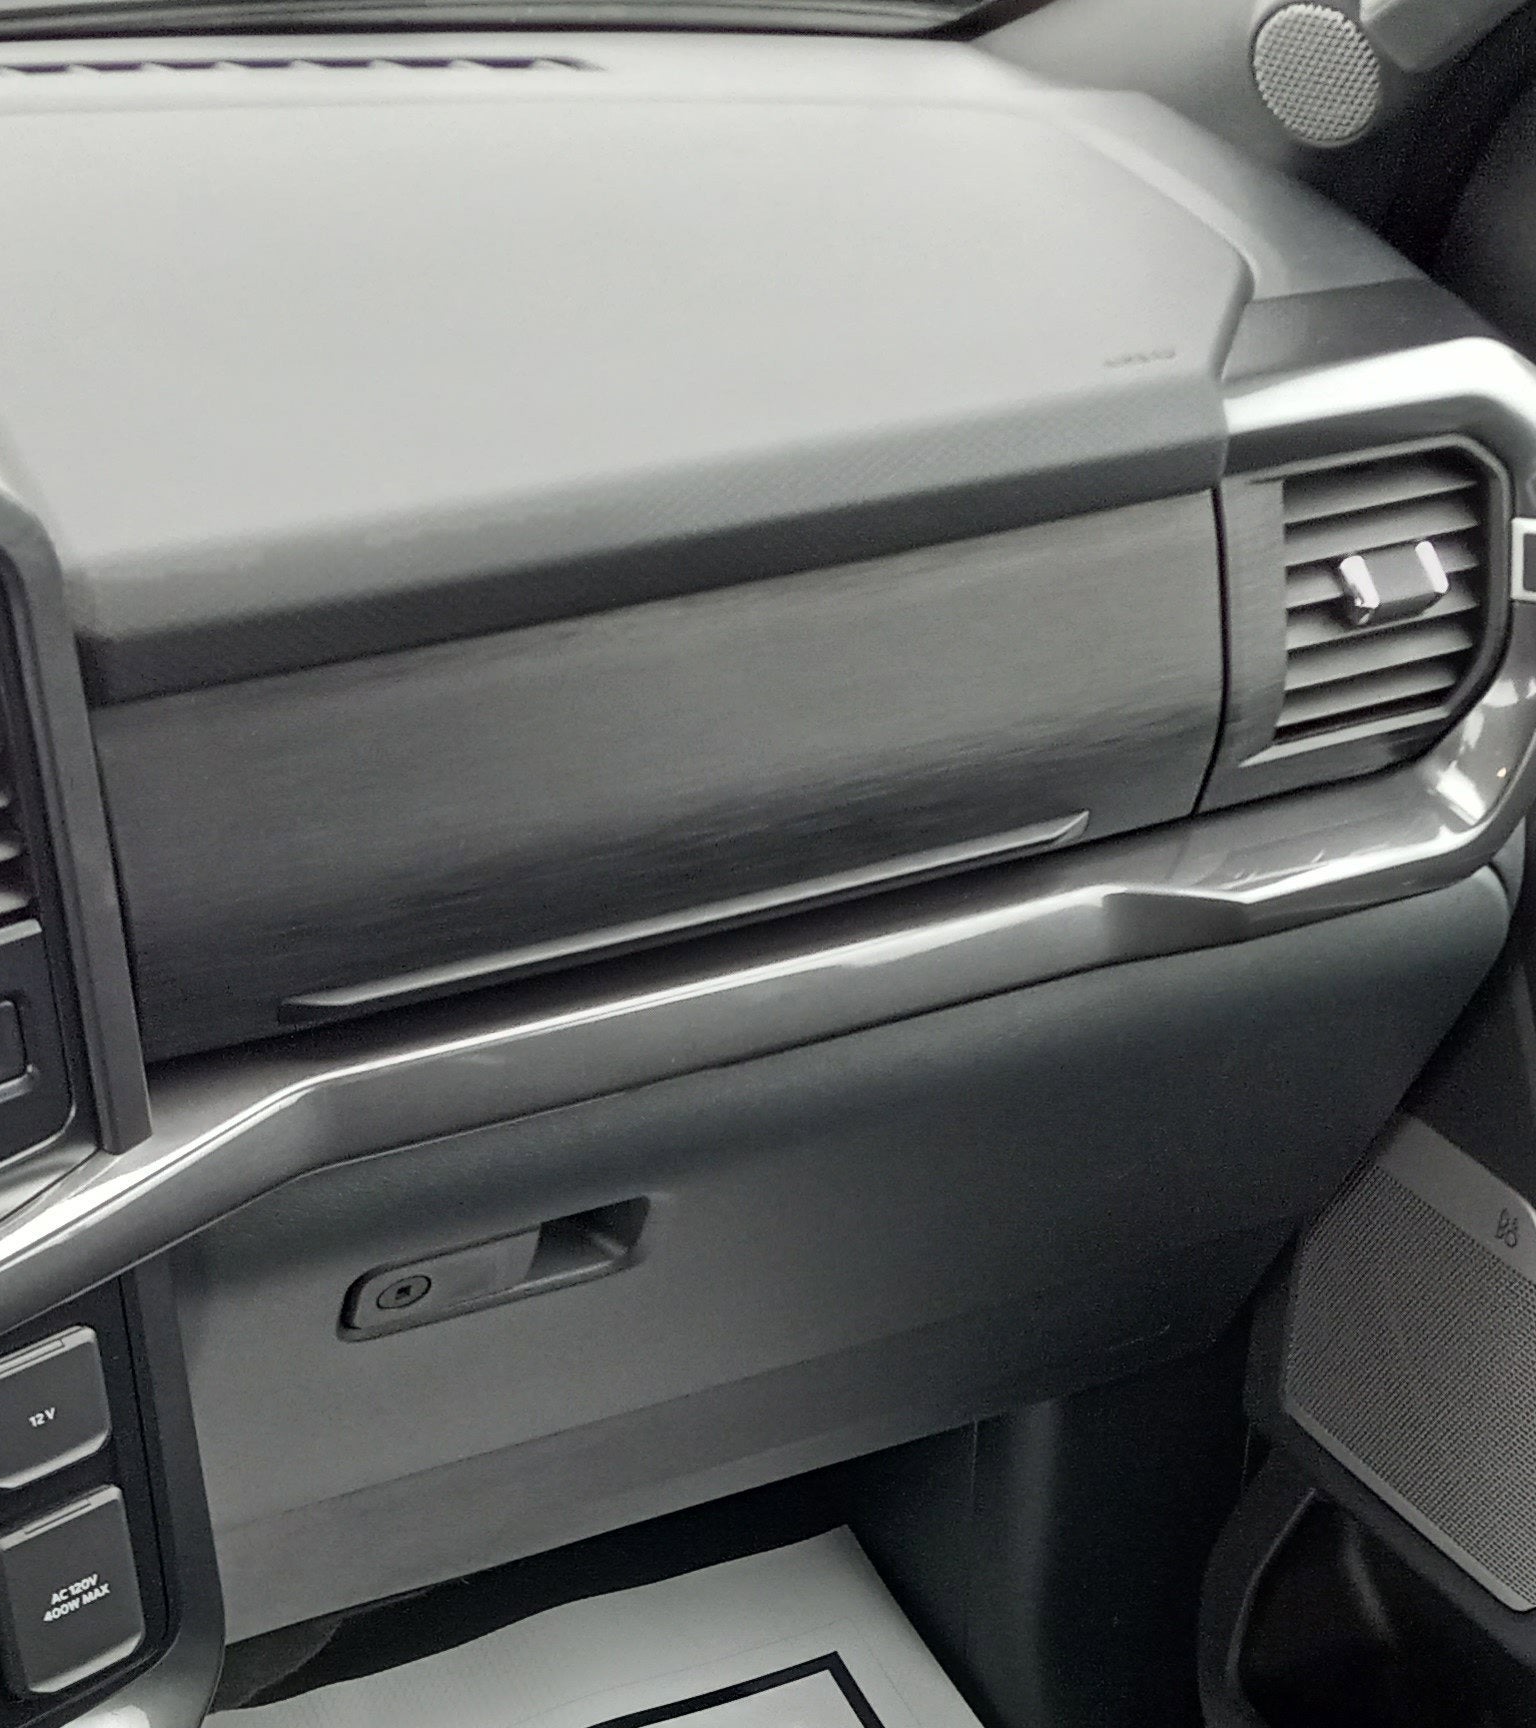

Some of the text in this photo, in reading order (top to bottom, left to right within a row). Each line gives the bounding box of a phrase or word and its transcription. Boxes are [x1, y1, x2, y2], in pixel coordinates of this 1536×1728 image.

[43, 1583, 111, 1622] 400W MAX
[50, 1573, 99, 1606] AC 120V
